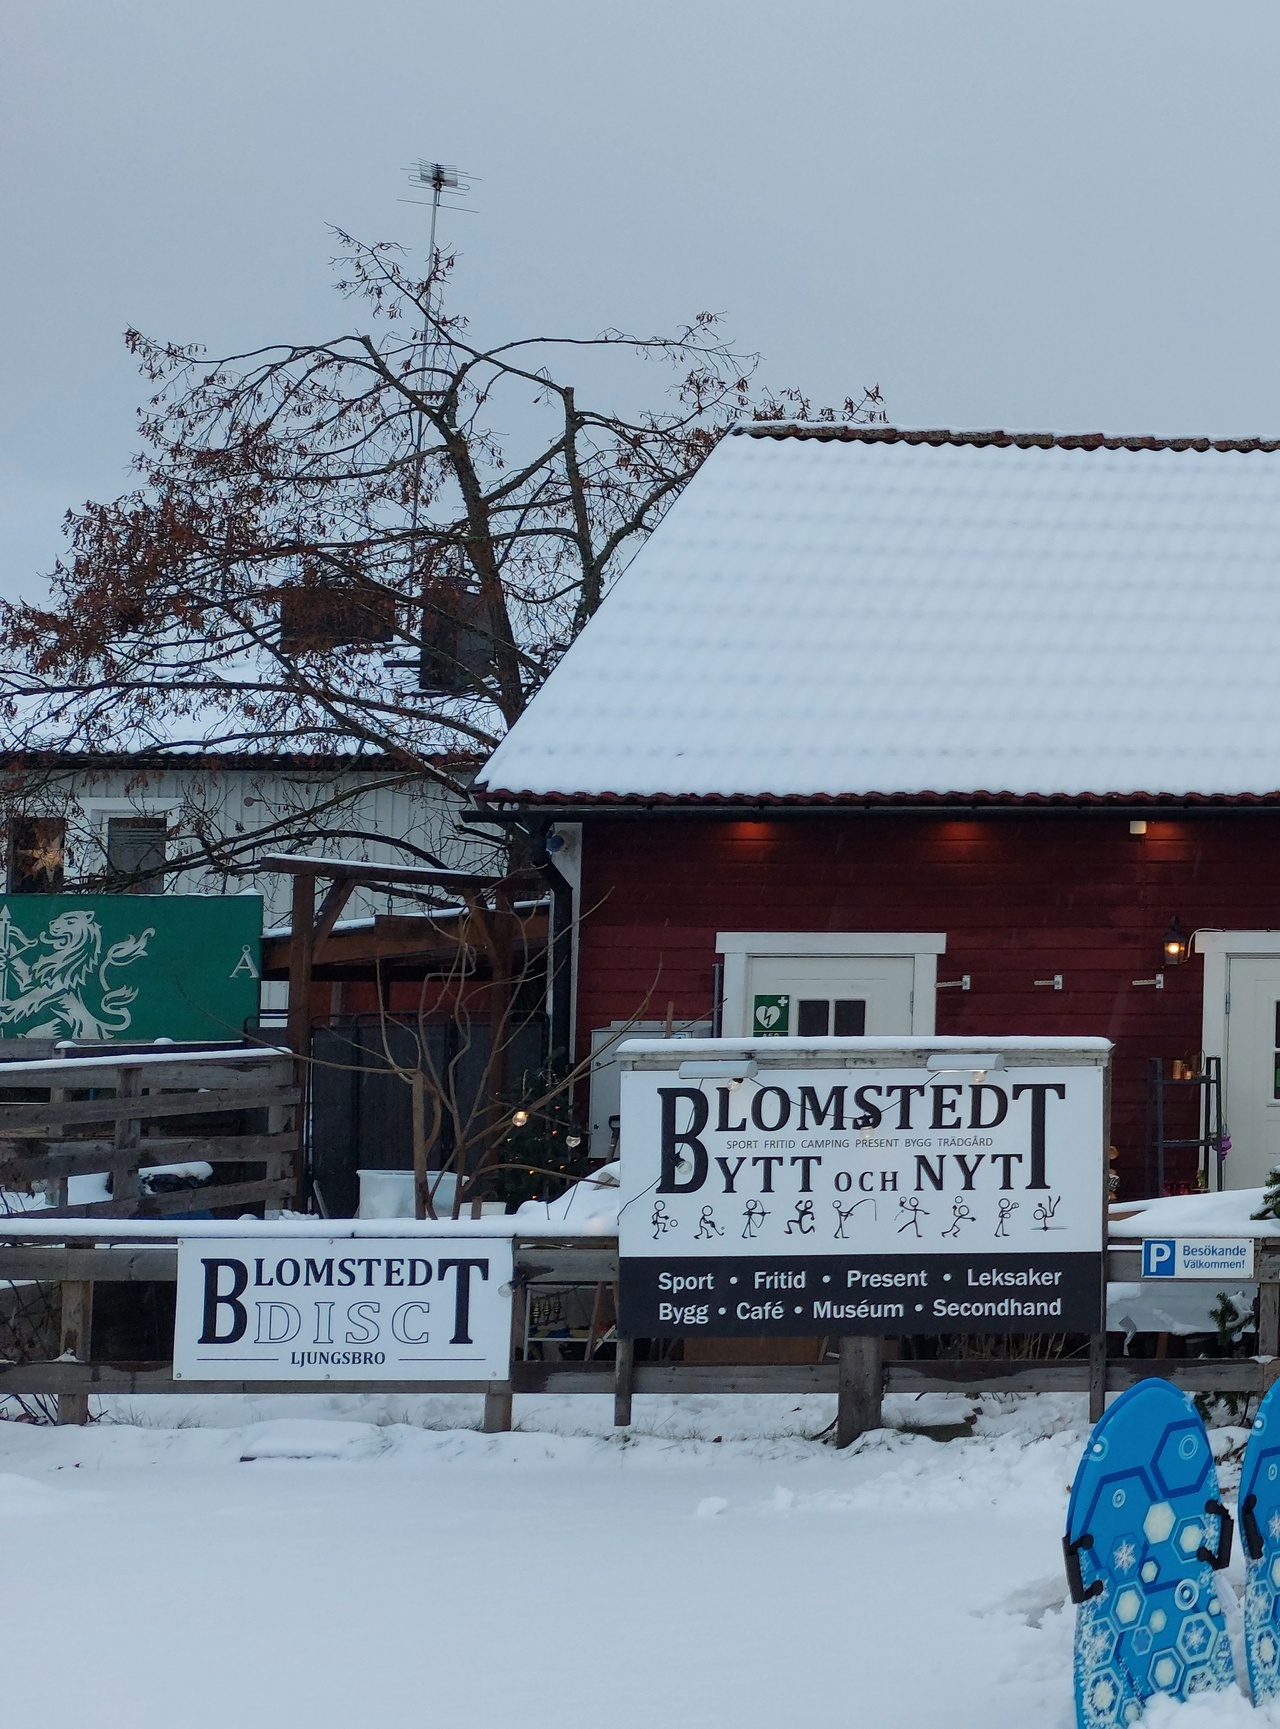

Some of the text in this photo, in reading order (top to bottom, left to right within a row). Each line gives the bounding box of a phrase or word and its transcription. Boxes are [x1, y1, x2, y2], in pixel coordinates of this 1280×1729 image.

[230, 944, 260, 978] Å
[726, 1134, 993, 1149] SPORT FRITID CAMPING PRESENT BYGG TRÄDGÅRD
[833, 1170, 899, 1192] OCH
[1182, 1244, 1247, 1256] Besökande
[1183, 1259, 1245, 1269] Välkommen!
[658, 1268, 1062, 1293] Sport Fritid Present Leksaker
[658, 1297, 1062, 1325] Bygg Café Muséum Secondhand
[254, 1301, 430, 1344] DISC
[290, 1350, 386, 1367] LJUNGSBRO
